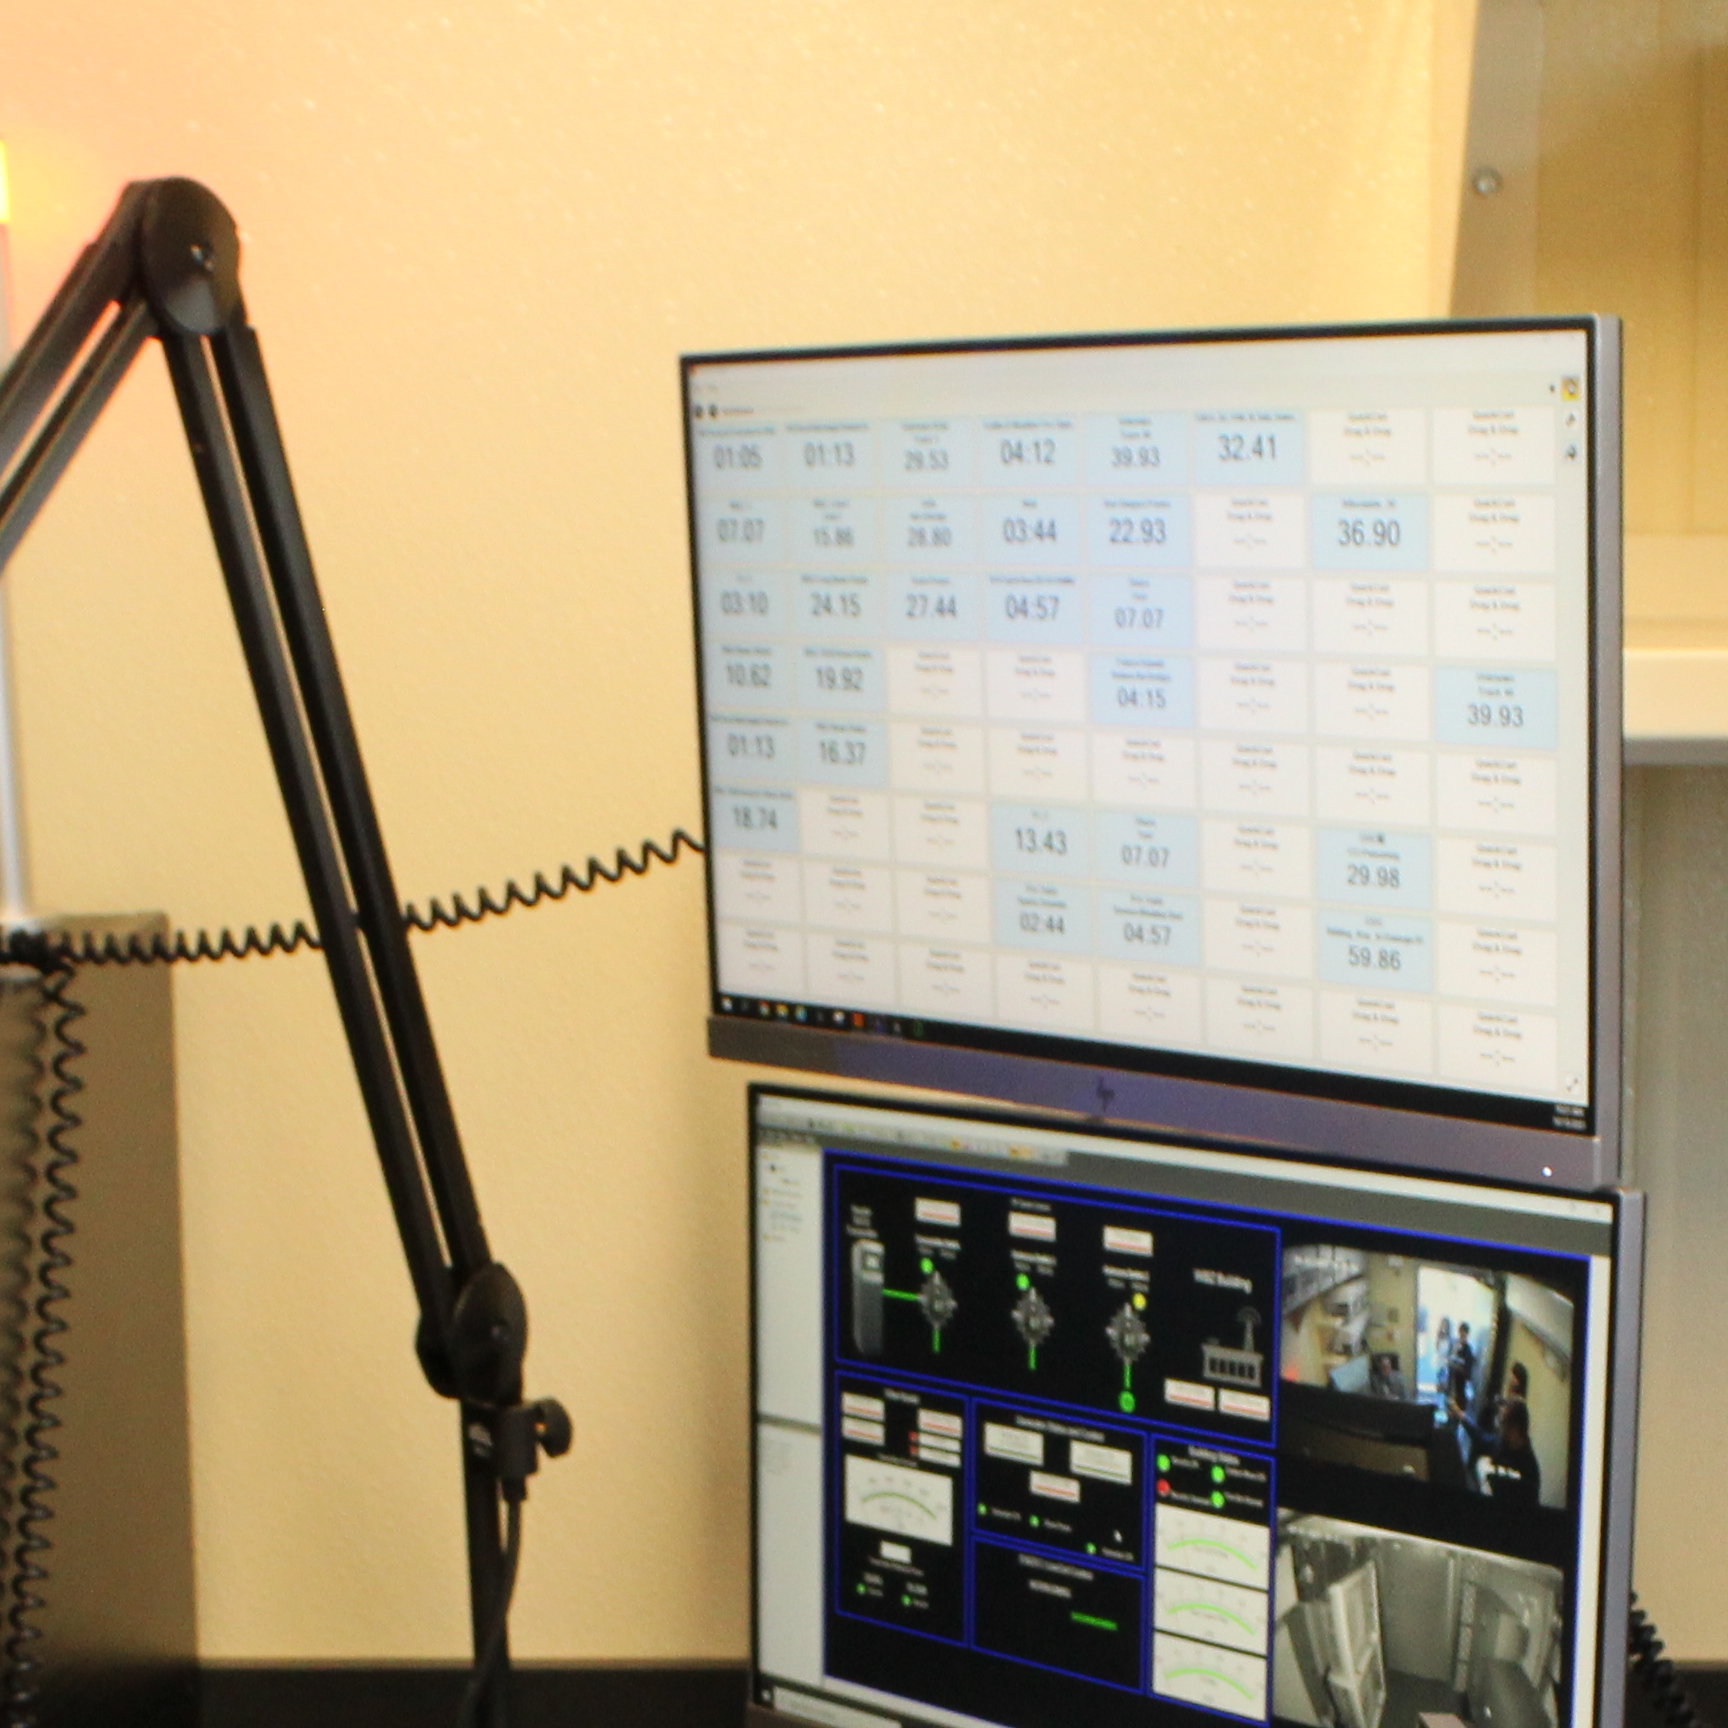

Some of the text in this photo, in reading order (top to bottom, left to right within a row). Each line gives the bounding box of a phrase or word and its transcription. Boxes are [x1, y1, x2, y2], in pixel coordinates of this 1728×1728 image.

[1001, 439, 1056, 465] 04:12
[1112, 448, 1161, 468] 39.93
[1219, 434, 1277, 462] 32.41
[1003, 519, 1057, 544] 03:44
[1109, 517, 1166, 544] 22.93
[1338, 519, 1400, 548] 36.90
[906, 594, 957, 618] 27.44
[1005, 595, 1059, 621] 04:57
[1467, 703, 1524, 728] 39.93
[1016, 828, 1067, 856] 13.43
[1347, 863, 1401, 889] 29.98
[1348, 945, 1401, 972] 59.86
